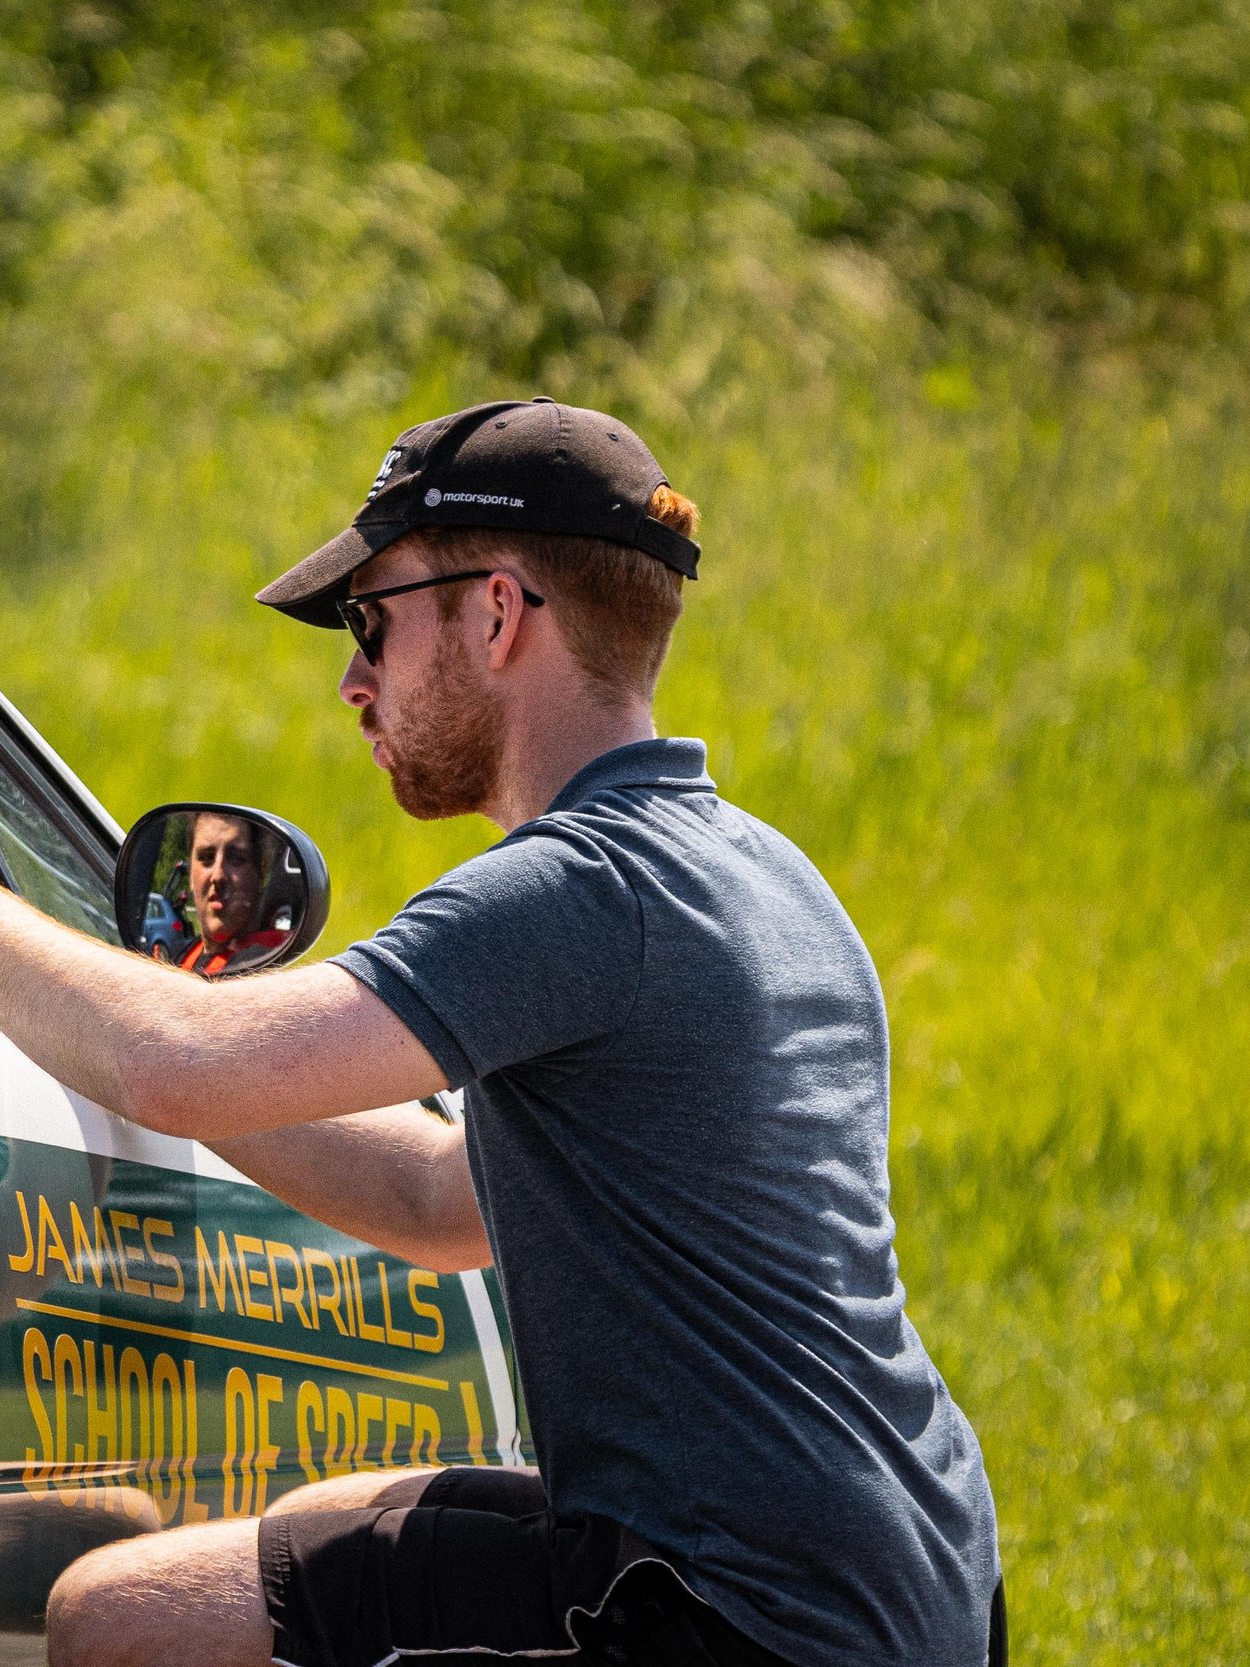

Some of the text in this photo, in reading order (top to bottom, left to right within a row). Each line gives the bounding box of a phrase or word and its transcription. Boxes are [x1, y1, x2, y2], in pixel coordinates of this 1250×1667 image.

[443, 491, 509, 506] motorsport
[8, 1190, 446, 1354] JAMES MERRILLS
[22, 1326, 209, 1526] SCHOOL
[222, 1366, 284, 1520] OF
